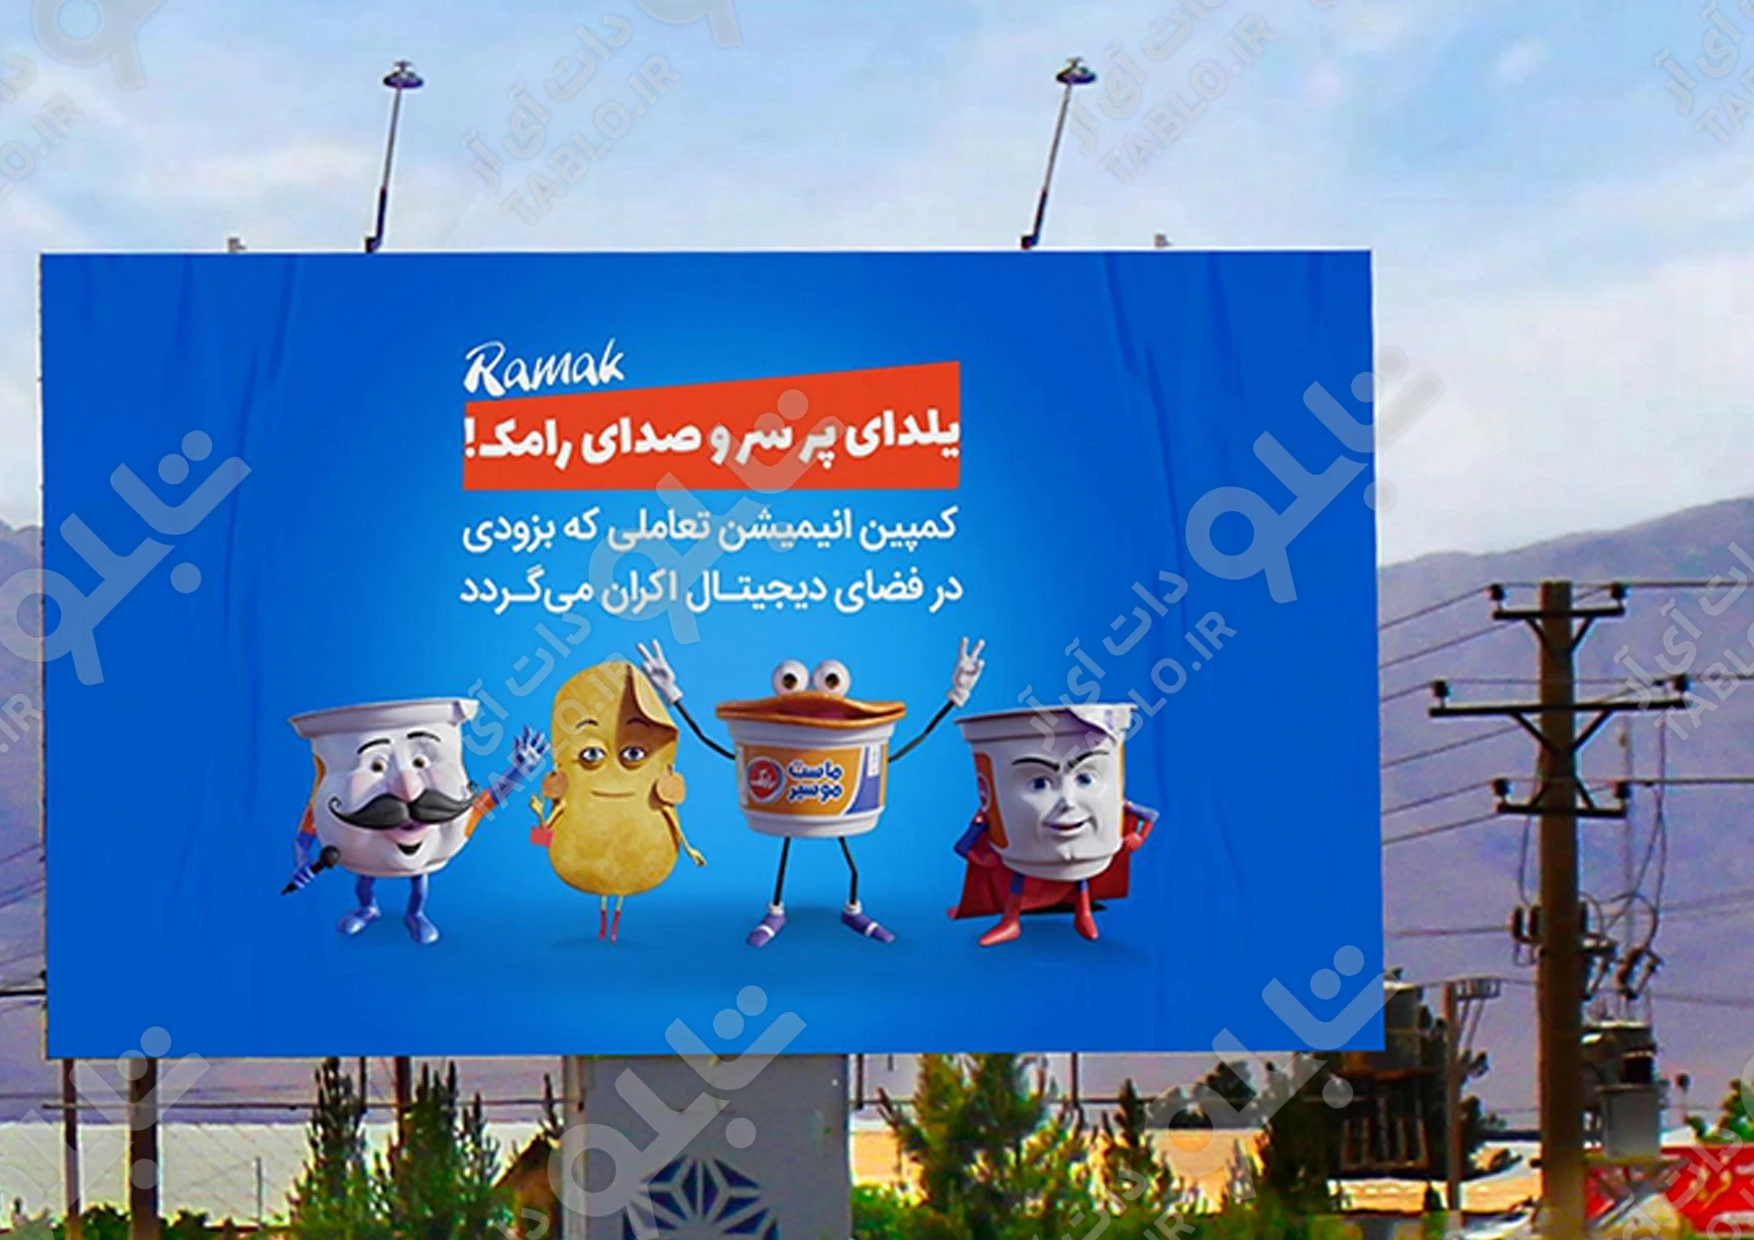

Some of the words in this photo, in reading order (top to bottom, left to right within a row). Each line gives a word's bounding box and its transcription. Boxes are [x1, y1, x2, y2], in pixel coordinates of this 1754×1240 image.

[463, 338, 625, 397] Ramak
[464, 416, 573, 471] رامک!
[581, 416, 702, 465] صدای
[710, 423, 730, 466] و
[735, 426, 793, 465] سر
[798, 425, 836, 469] پر
[846, 409, 960, 458] یلدای
[462, 514, 556, 553] بزودی
[563, 506, 600, 541] که
[607, 508, 711, 552] تعاملی
[718, 507, 852, 552] انیمیشن
[859, 505, 959, 552] کمپین
[601, 567, 678, 615] اکران
[834, 566, 925, 614] فضای
[928, 575, 964, 614] در
[788, 759, 843, 781] ماست
